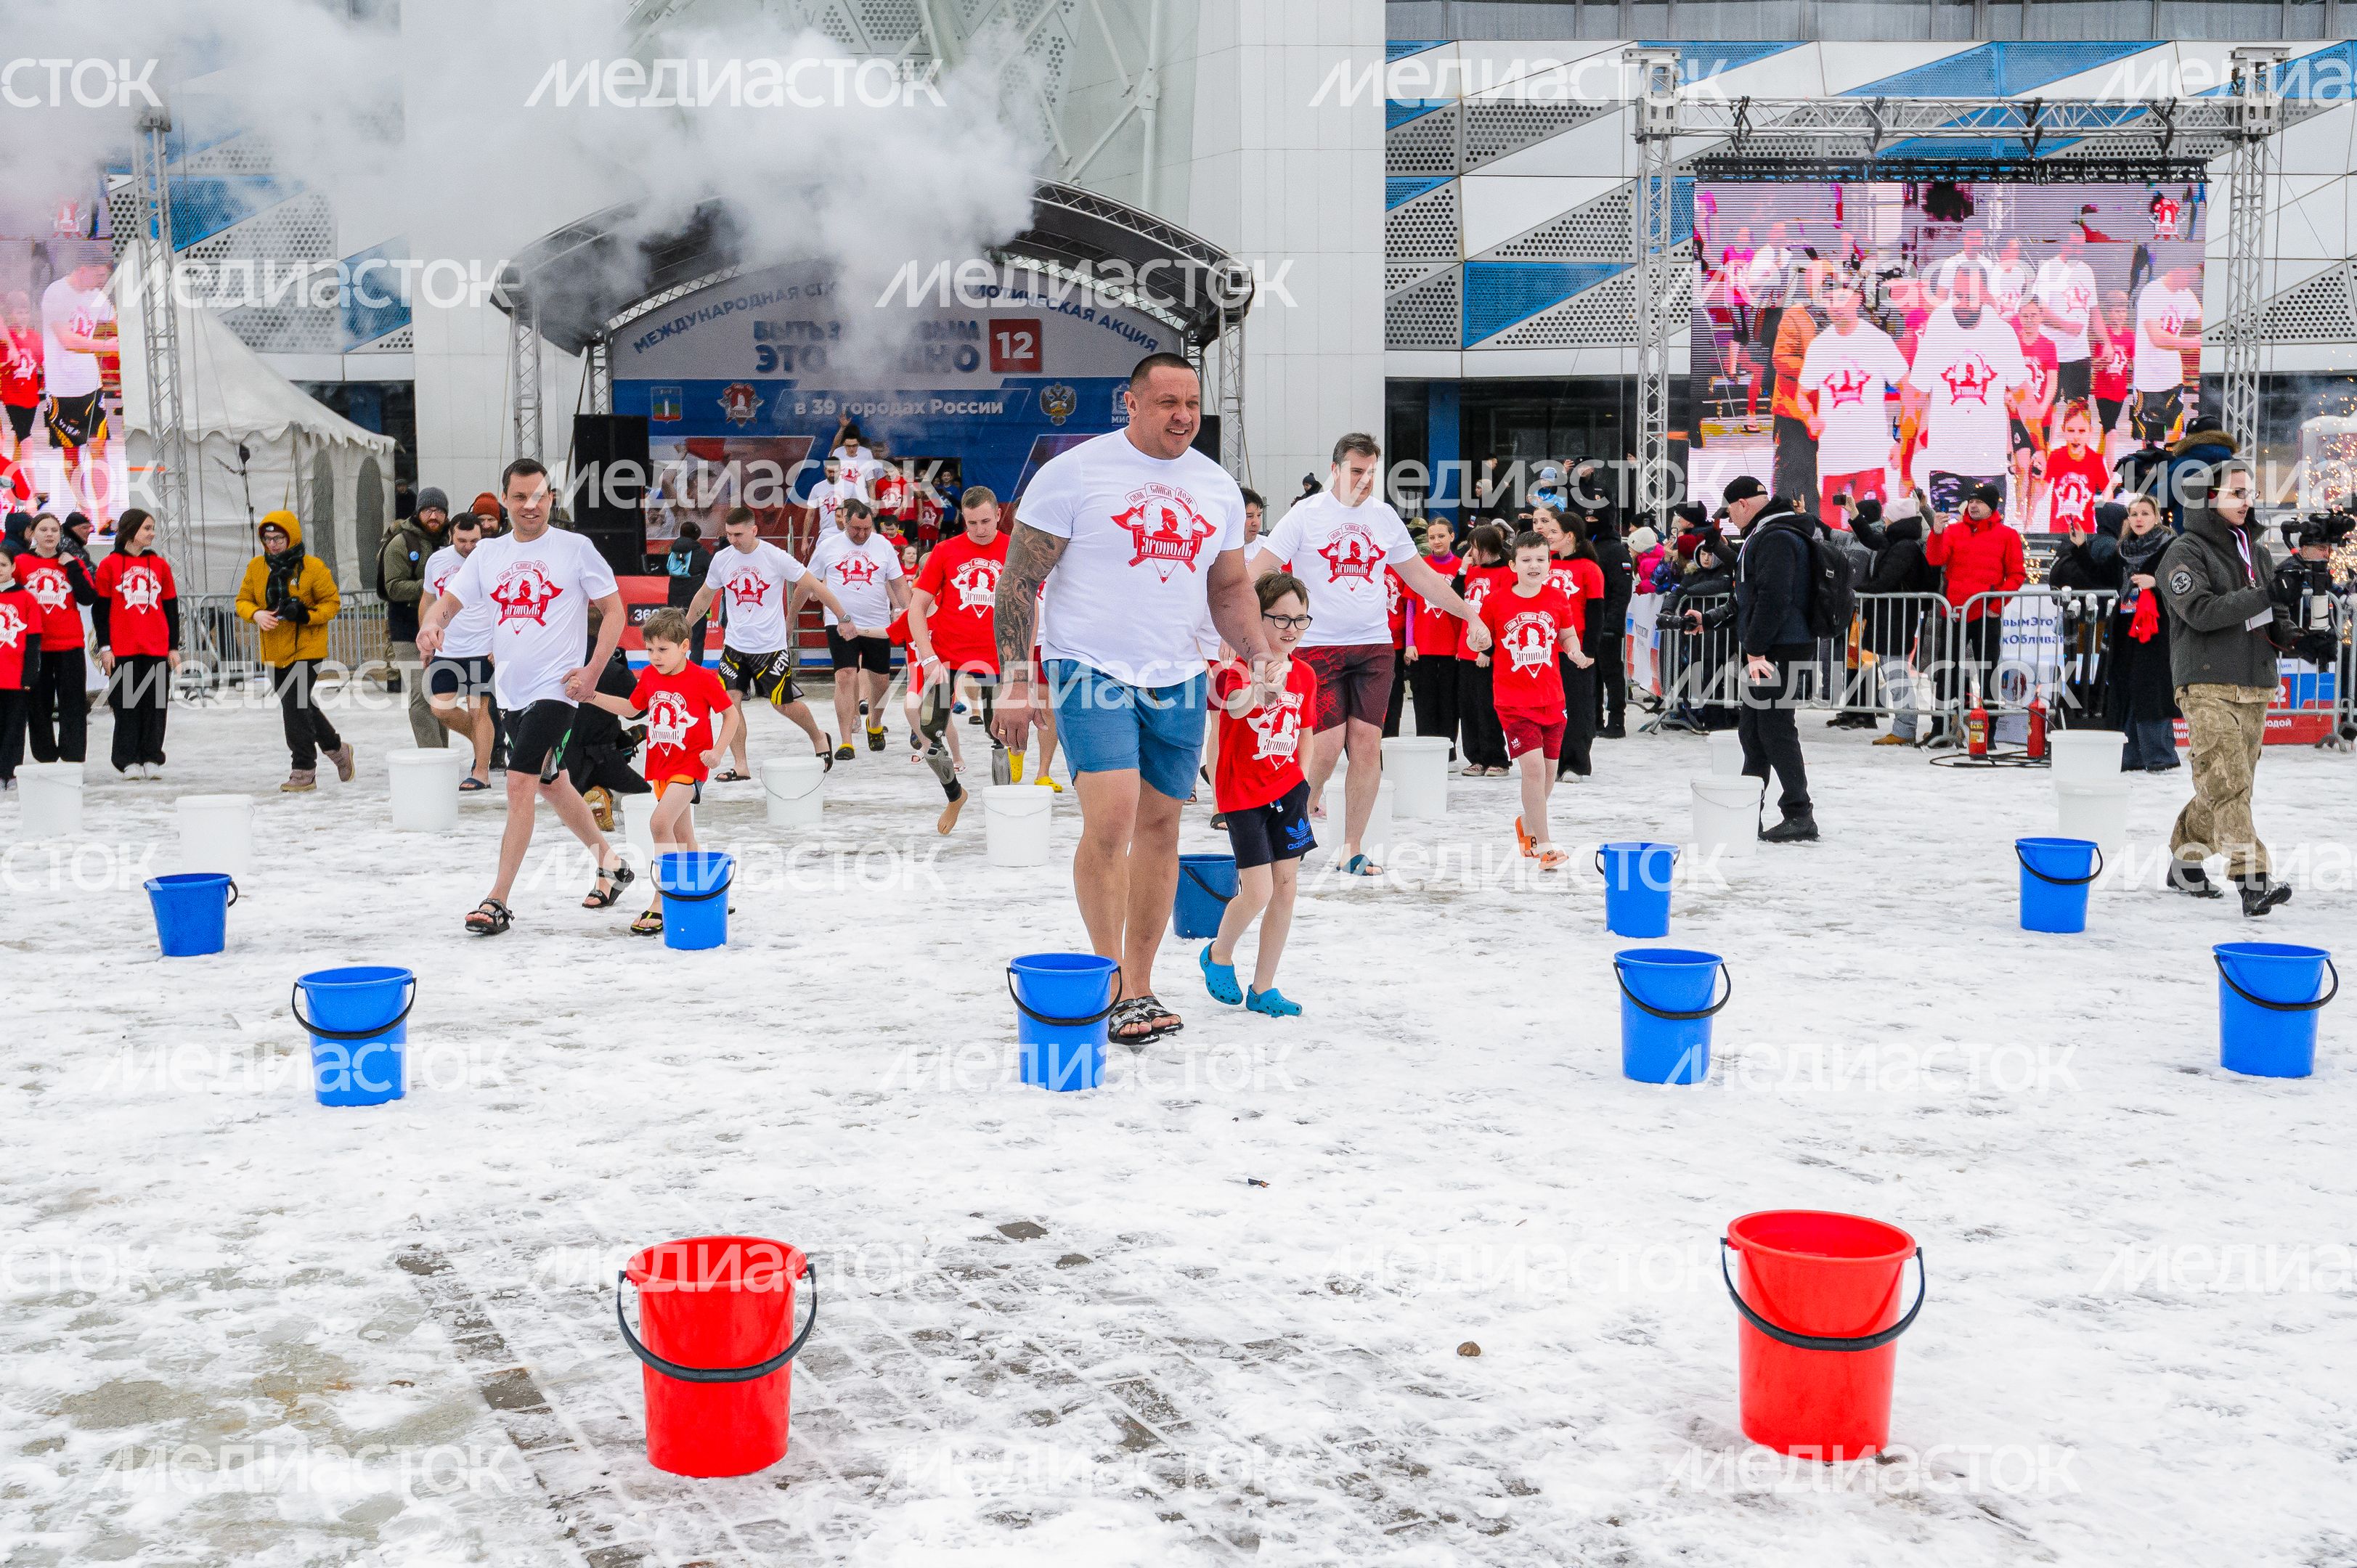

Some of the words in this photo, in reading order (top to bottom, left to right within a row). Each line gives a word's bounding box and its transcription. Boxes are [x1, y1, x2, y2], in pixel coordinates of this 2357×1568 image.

[632, 285, 799, 354] МЕЖДУНАРОДНАЯ
[1097, 313, 1160, 354] АКЦИЯ
[754, 344, 827, 373] ЭТО
[996, 331, 1035, 359] 12
[794, 402, 807, 415] в
[811, 399, 836, 415] 39
[842, 402, 926, 420] городах
[929, 399, 1004, 415] России
[1287, 834, 1314, 850] adidas
